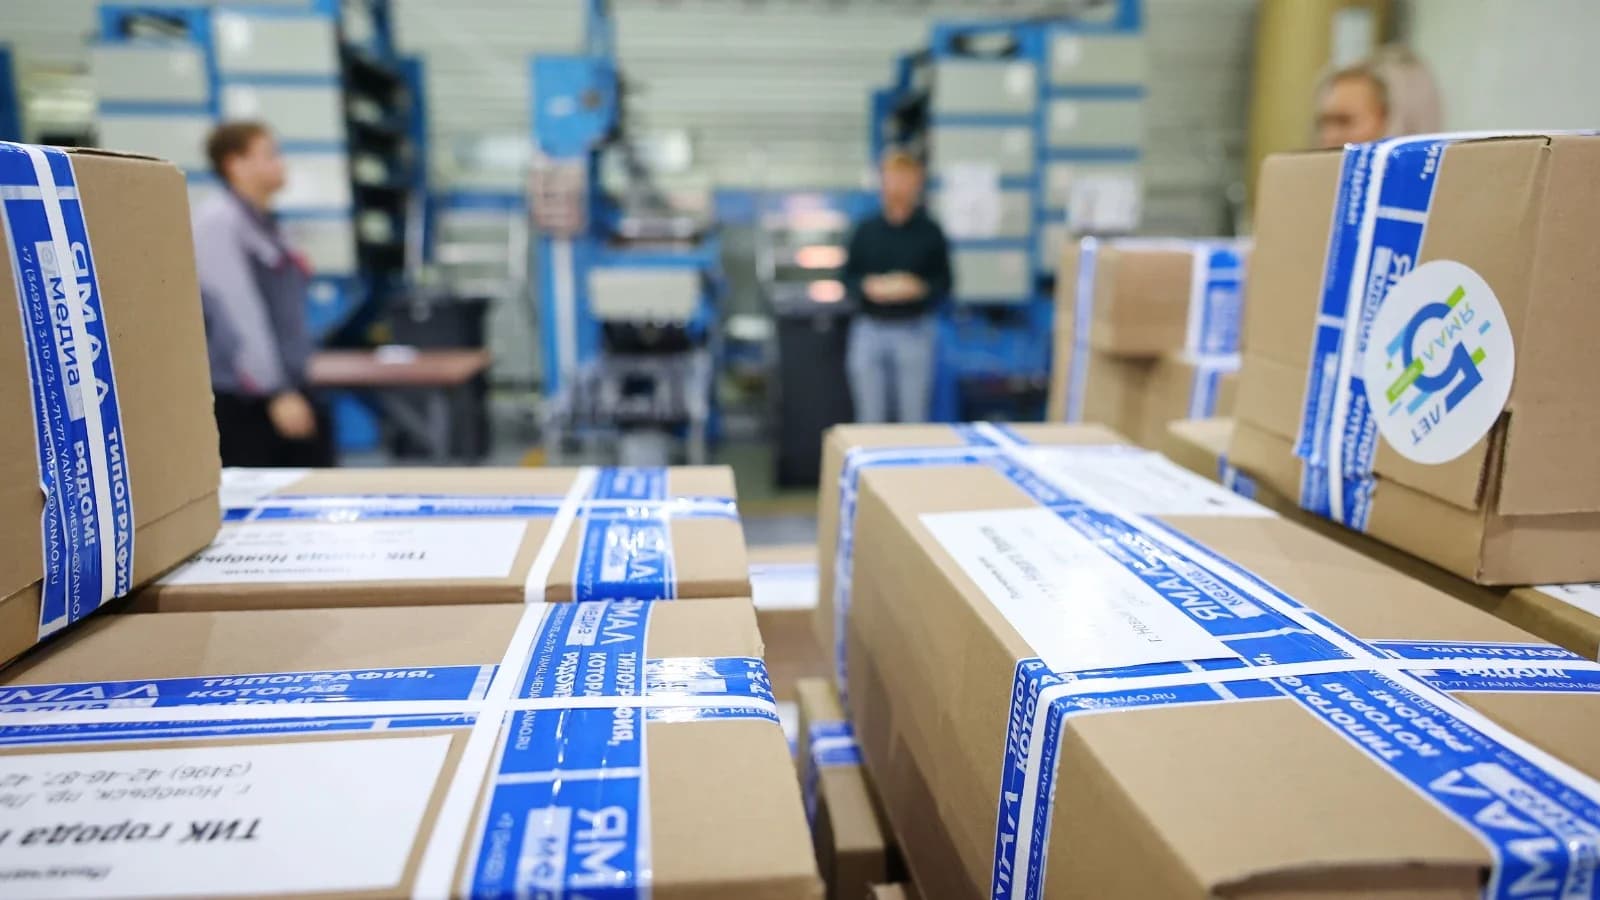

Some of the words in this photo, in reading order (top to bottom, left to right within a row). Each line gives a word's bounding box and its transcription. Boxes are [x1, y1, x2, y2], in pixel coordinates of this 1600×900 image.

[22, 245, 33, 264] +7
[25, 267, 45, 326] (34922)
[39, 328, 57, 385] 3-10-73,
[50, 277, 81, 386] медиа
[1423, 302, 1476, 361] ЯМАЛ
[50, 390, 65, 448] 4-71-77,
[1410, 403, 1441, 445] ЛЕТ
[73, 440, 96, 548] РЯДОМ!
[1139, 565, 1235, 620] ЯМАЛ
[186, 683, 350, 699] КОТОРАЯ
[202, 669, 435, 688] ТИПОГРАФИЯ,
[514, 654, 551, 751] YAMAL-MEDIAANAO.RU
[584, 652, 607, 698] КОТОРА
[607, 651, 638, 746] ТИПОГРФИЯ,
[1321, 682, 1442, 758] КОТОРАЯ
[18, 820, 174, 847] города
[177, 818, 262, 846] ТИК
[1428, 769, 1558, 900] МАЛ
